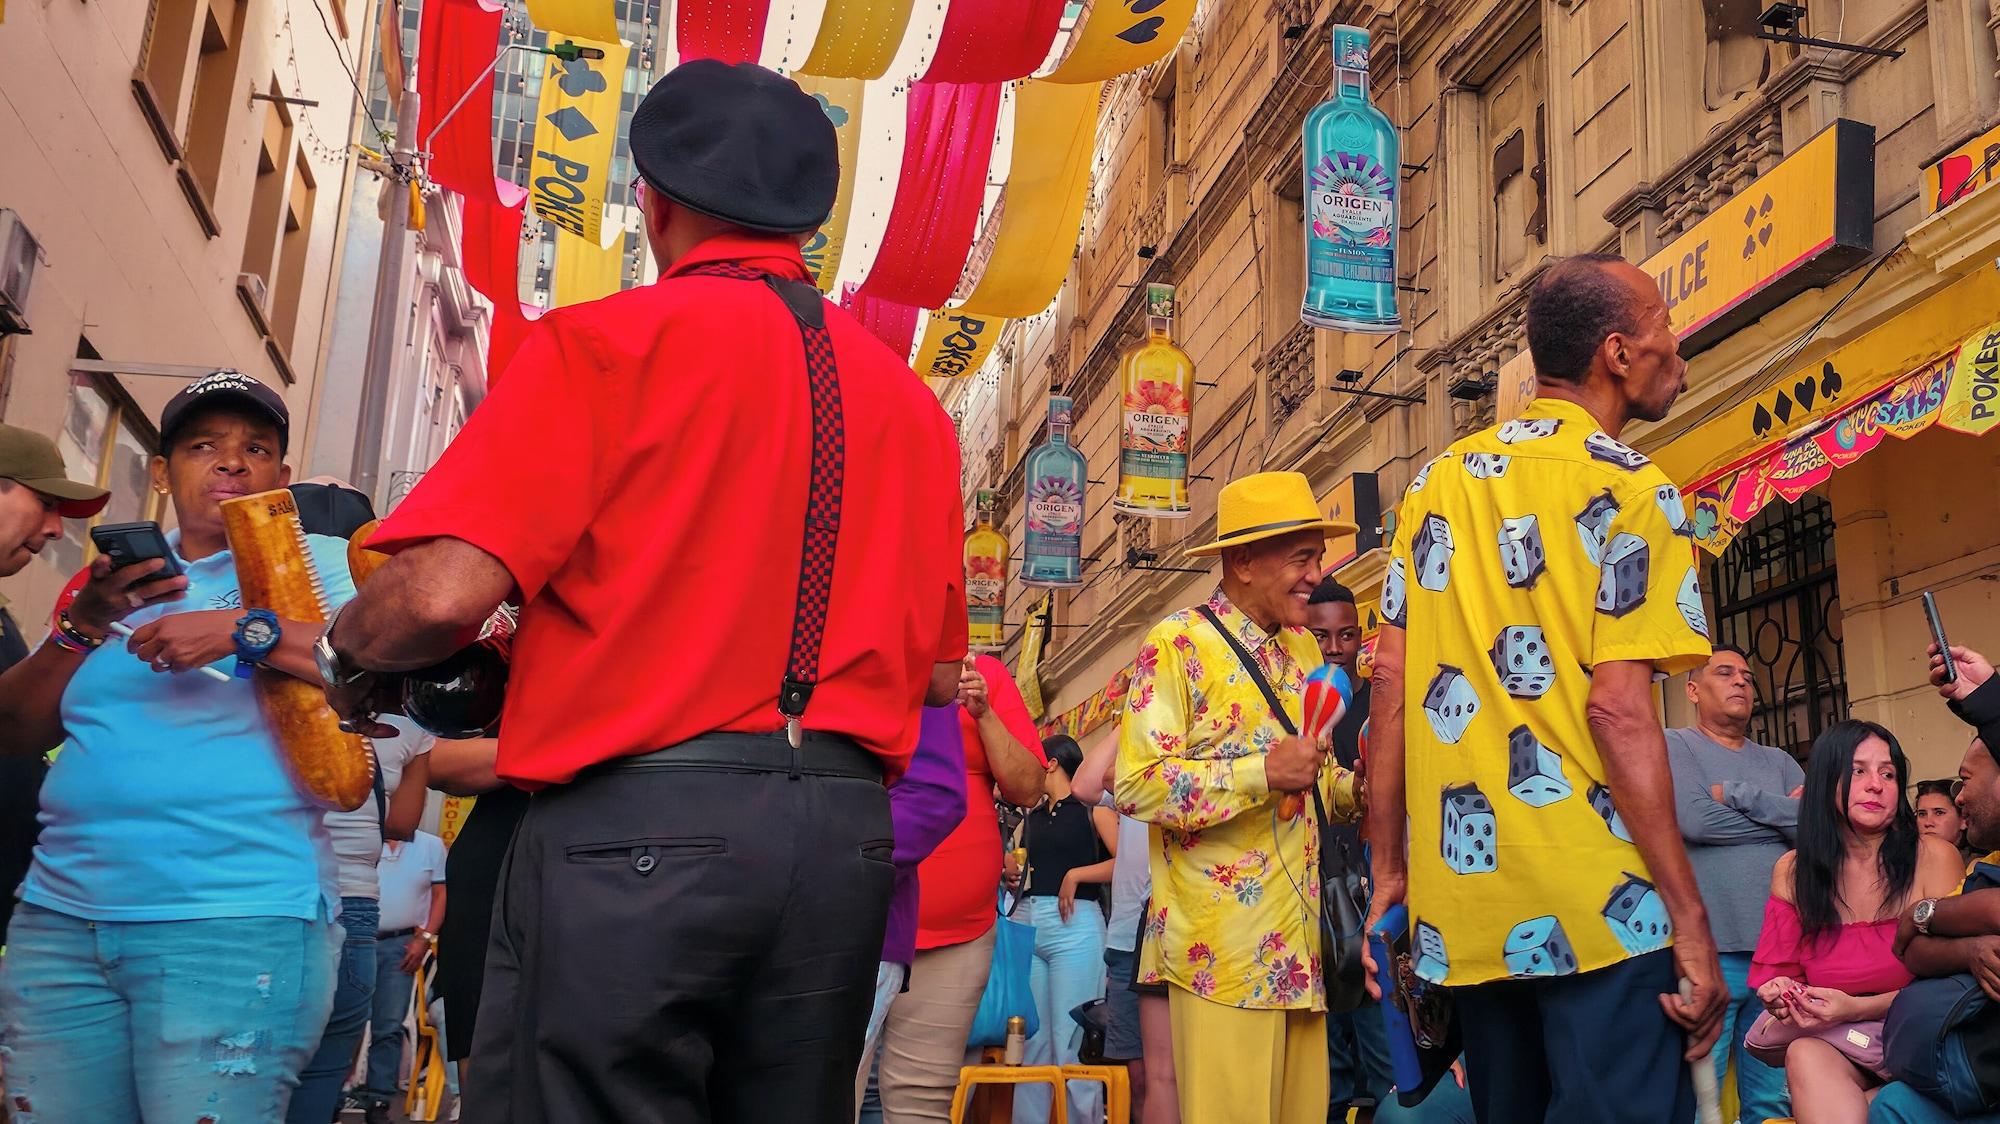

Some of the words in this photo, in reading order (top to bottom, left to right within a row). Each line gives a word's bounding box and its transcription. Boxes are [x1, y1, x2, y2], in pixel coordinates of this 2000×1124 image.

[1322, 194, 1383, 212] ORIGEN
[1971, 330, 2000, 421] POKER
[1133, 413, 1180, 425] ORIGEN
[1895, 420, 1926, 432] POKER
[1782, 446, 1803, 461] UNA
[1036, 504, 1075, 513] ORIGEN
